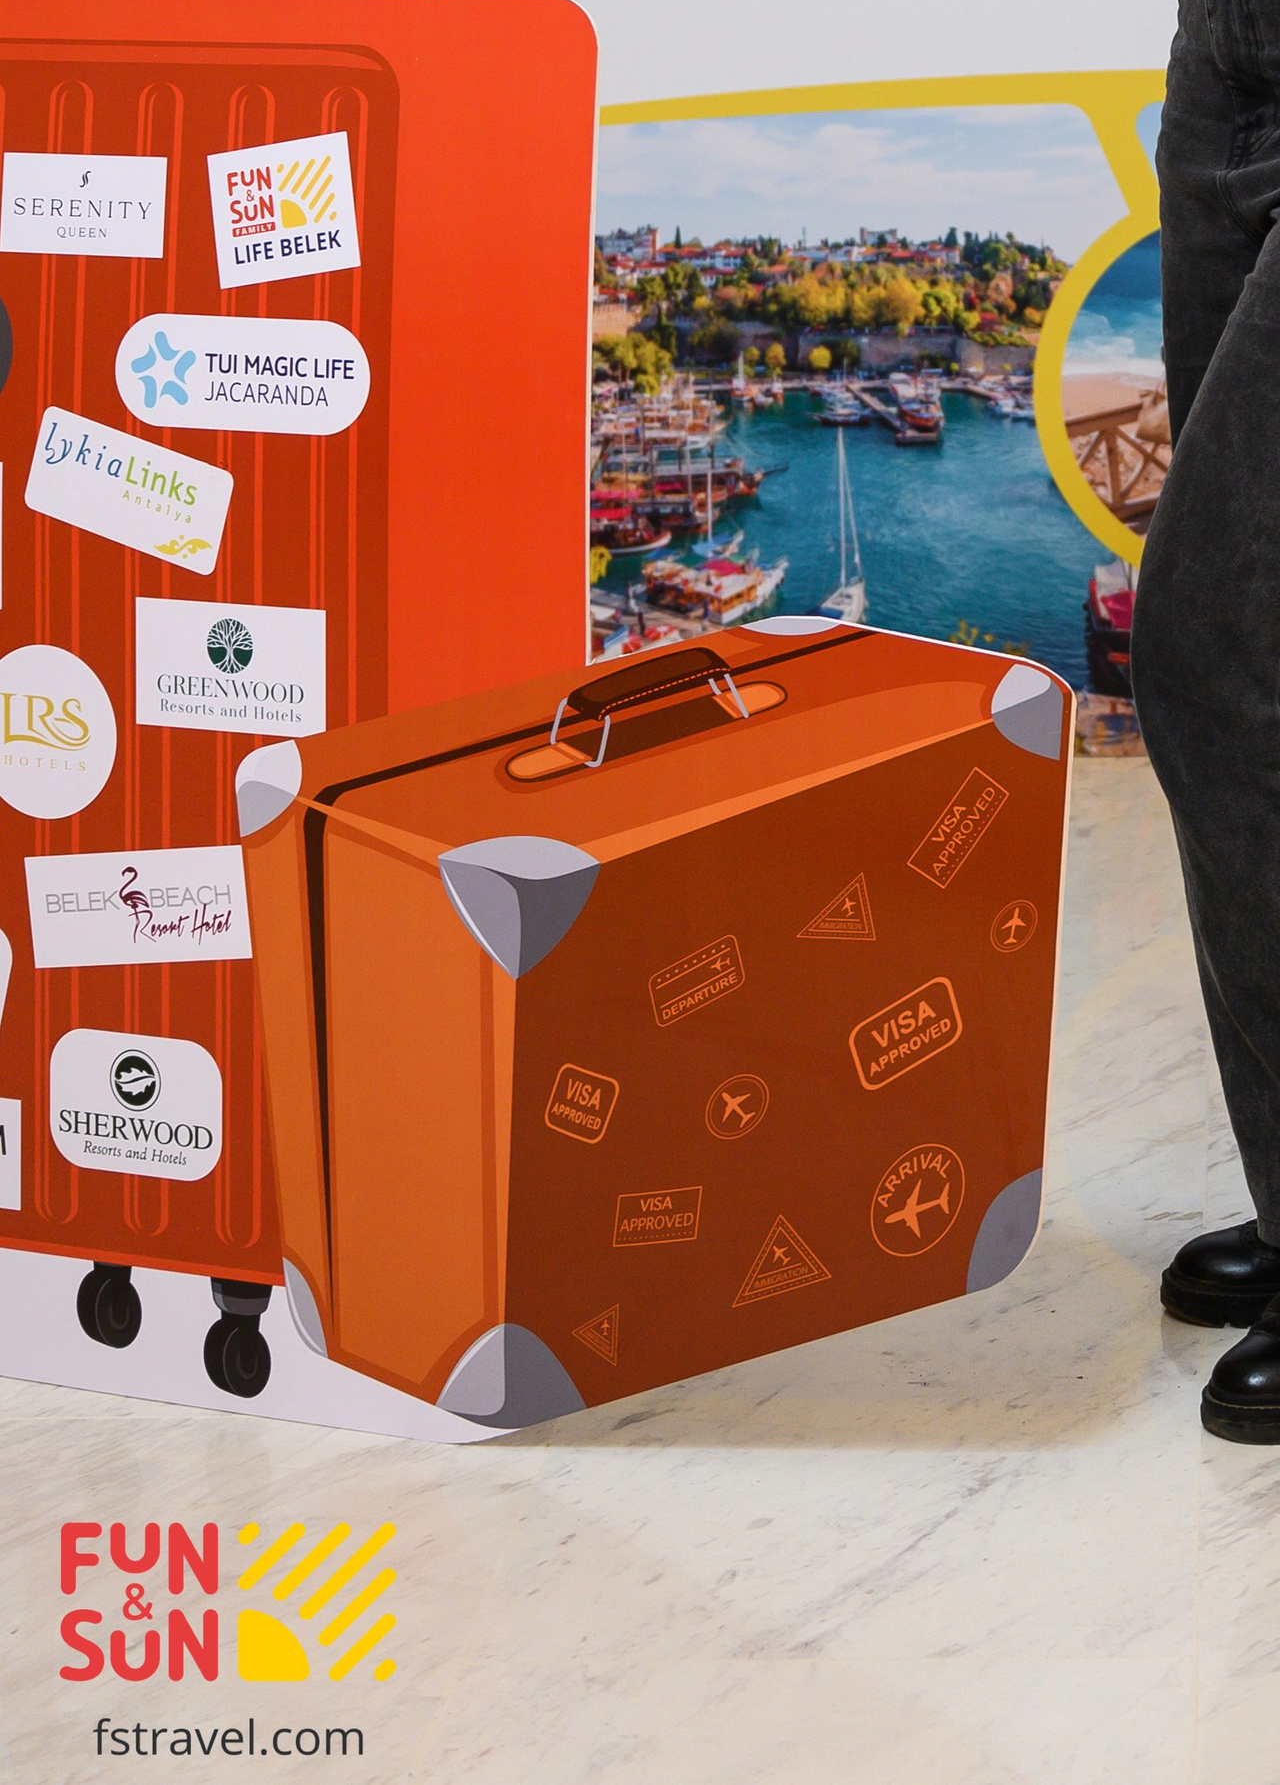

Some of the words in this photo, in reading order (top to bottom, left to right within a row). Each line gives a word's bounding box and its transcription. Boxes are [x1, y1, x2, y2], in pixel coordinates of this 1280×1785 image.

[227, 166, 272, 197] FUN
[246, 189, 255, 202] &
[13, 197, 152, 220] SERENITY
[230, 194, 275, 224] SUN
[56, 226, 108, 238] QUEEN
[236, 223, 274, 236] FAMILY
[234, 241, 274, 265] LIFE
[280, 229, 342, 257] BELEK
[205, 353, 240, 374] TUI
[244, 355, 309, 378] MAGIC
[313, 358, 356, 380] LIFE
[204, 381, 329, 407] JACARANDA
[122, 489, 192, 524] Antalya
[157, 673, 305, 705] GREENWOOD
[0, 692, 92, 752] LRS
[160, 698, 215, 716] Resorts
[220, 704, 248, 718] and
[254, 705, 302, 723] Hotels
[3, 754, 87, 772] HOTELS
[931, 804, 967, 844] VISA
[932, 787, 996, 876] APPROVED
[45, 890, 121, 914] BELEK
[149, 884, 232, 909] BEACH
[128, 909, 190, 944] Resort
[190, 903, 232, 946] Hotel
[661, 972, 738, 1020] DEPARTURE
[871, 1000, 938, 1048] VISA
[870, 1018, 951, 1077] APPROVED
[566, 1078, 602, 1111] VISA
[59, 1108, 214, 1150] SHERWOOD
[551, 1102, 602, 1131] APPROVED
[83, 1140, 122, 1158] Resorts
[125, 1147, 147, 1161] and
[151, 1149, 188, 1166] Hotels
[877, 1151, 951, 1208] ARRIVAL
[639, 1195, 673, 1213] VISA
[619, 1212, 694, 1233] APPROVED
[753, 1265, 809, 1289] IMMIGRATION
